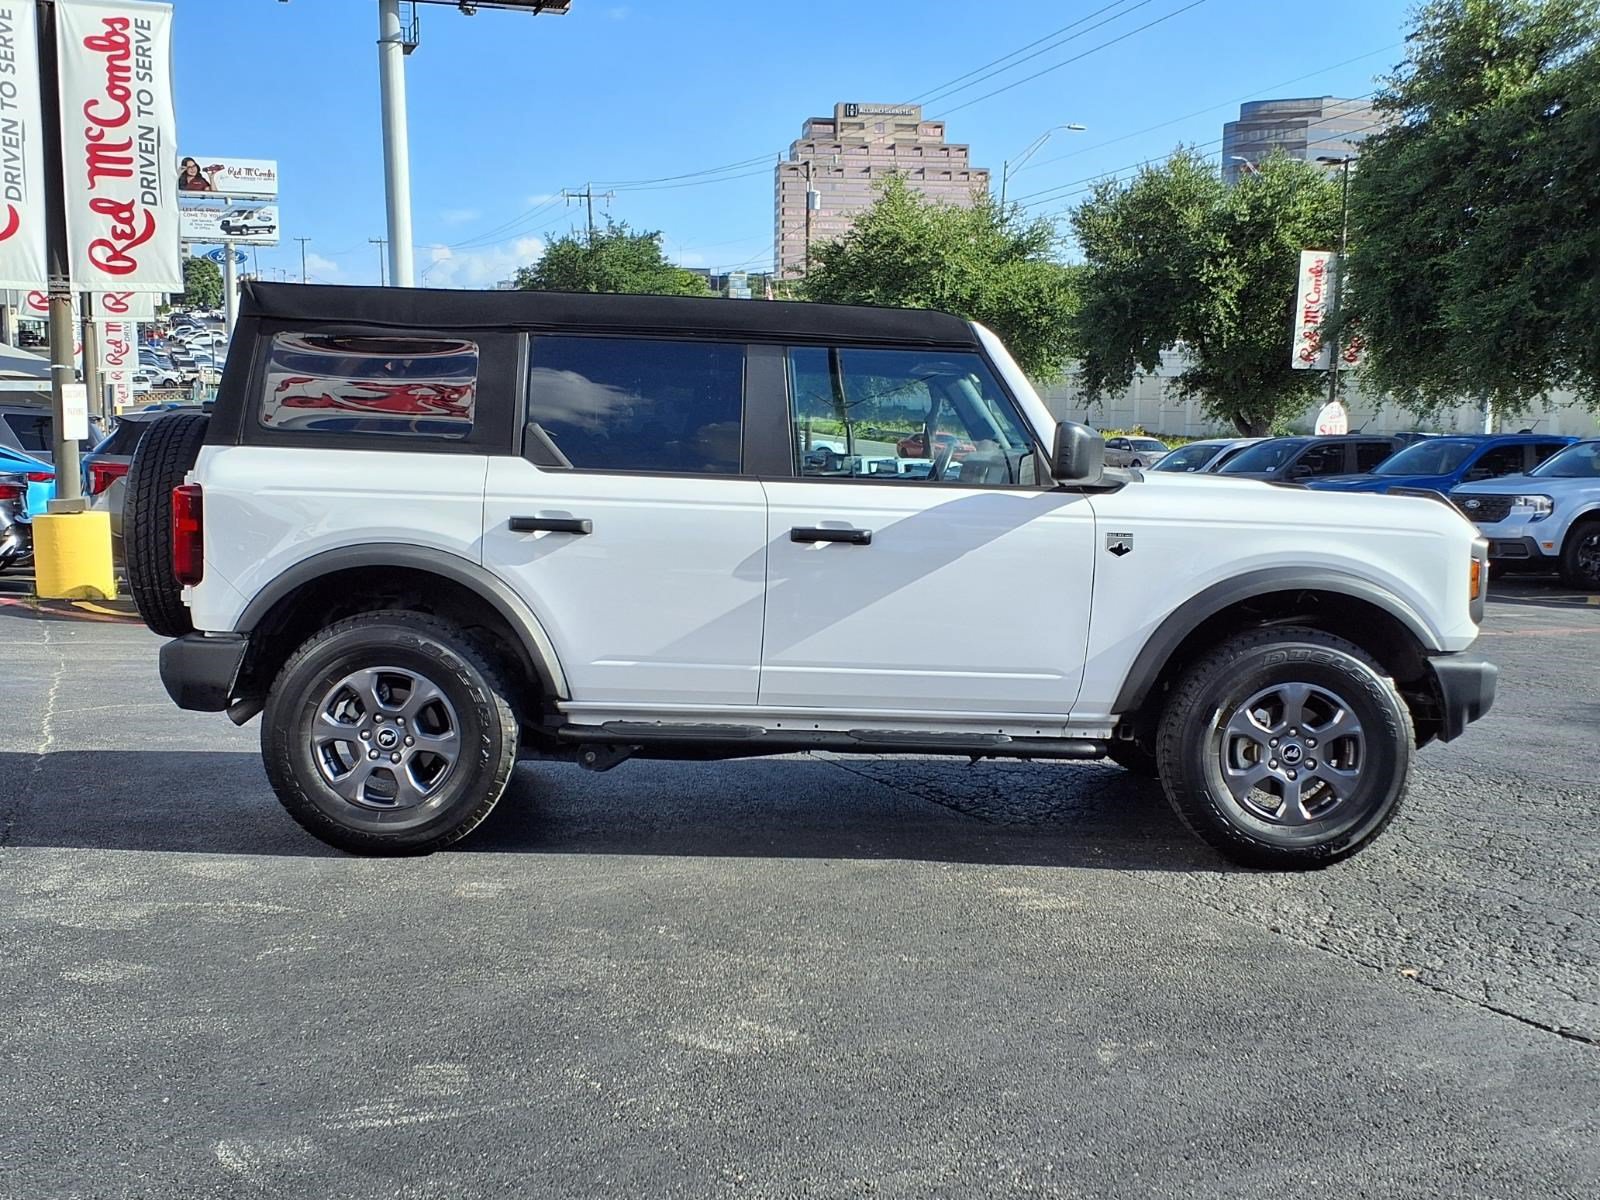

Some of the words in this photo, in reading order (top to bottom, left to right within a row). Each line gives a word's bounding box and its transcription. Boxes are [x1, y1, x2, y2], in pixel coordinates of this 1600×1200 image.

[0, 8, 16, 75] SERVE
[135, 18, 152, 83] SERVE
[0, 80, 18, 110] TO
[83, 17, 134, 190] McCombs
[137, 89, 154, 117] TO
[5, 119, 23, 202] DRIVEN
[138, 126, 158, 206] DRIVEN
[88, 198, 155, 275] Red
[106, 338, 130, 366] Red
[1319, 424, 1345, 434] SALE
[1262, 648, 1385, 700] DUELER
